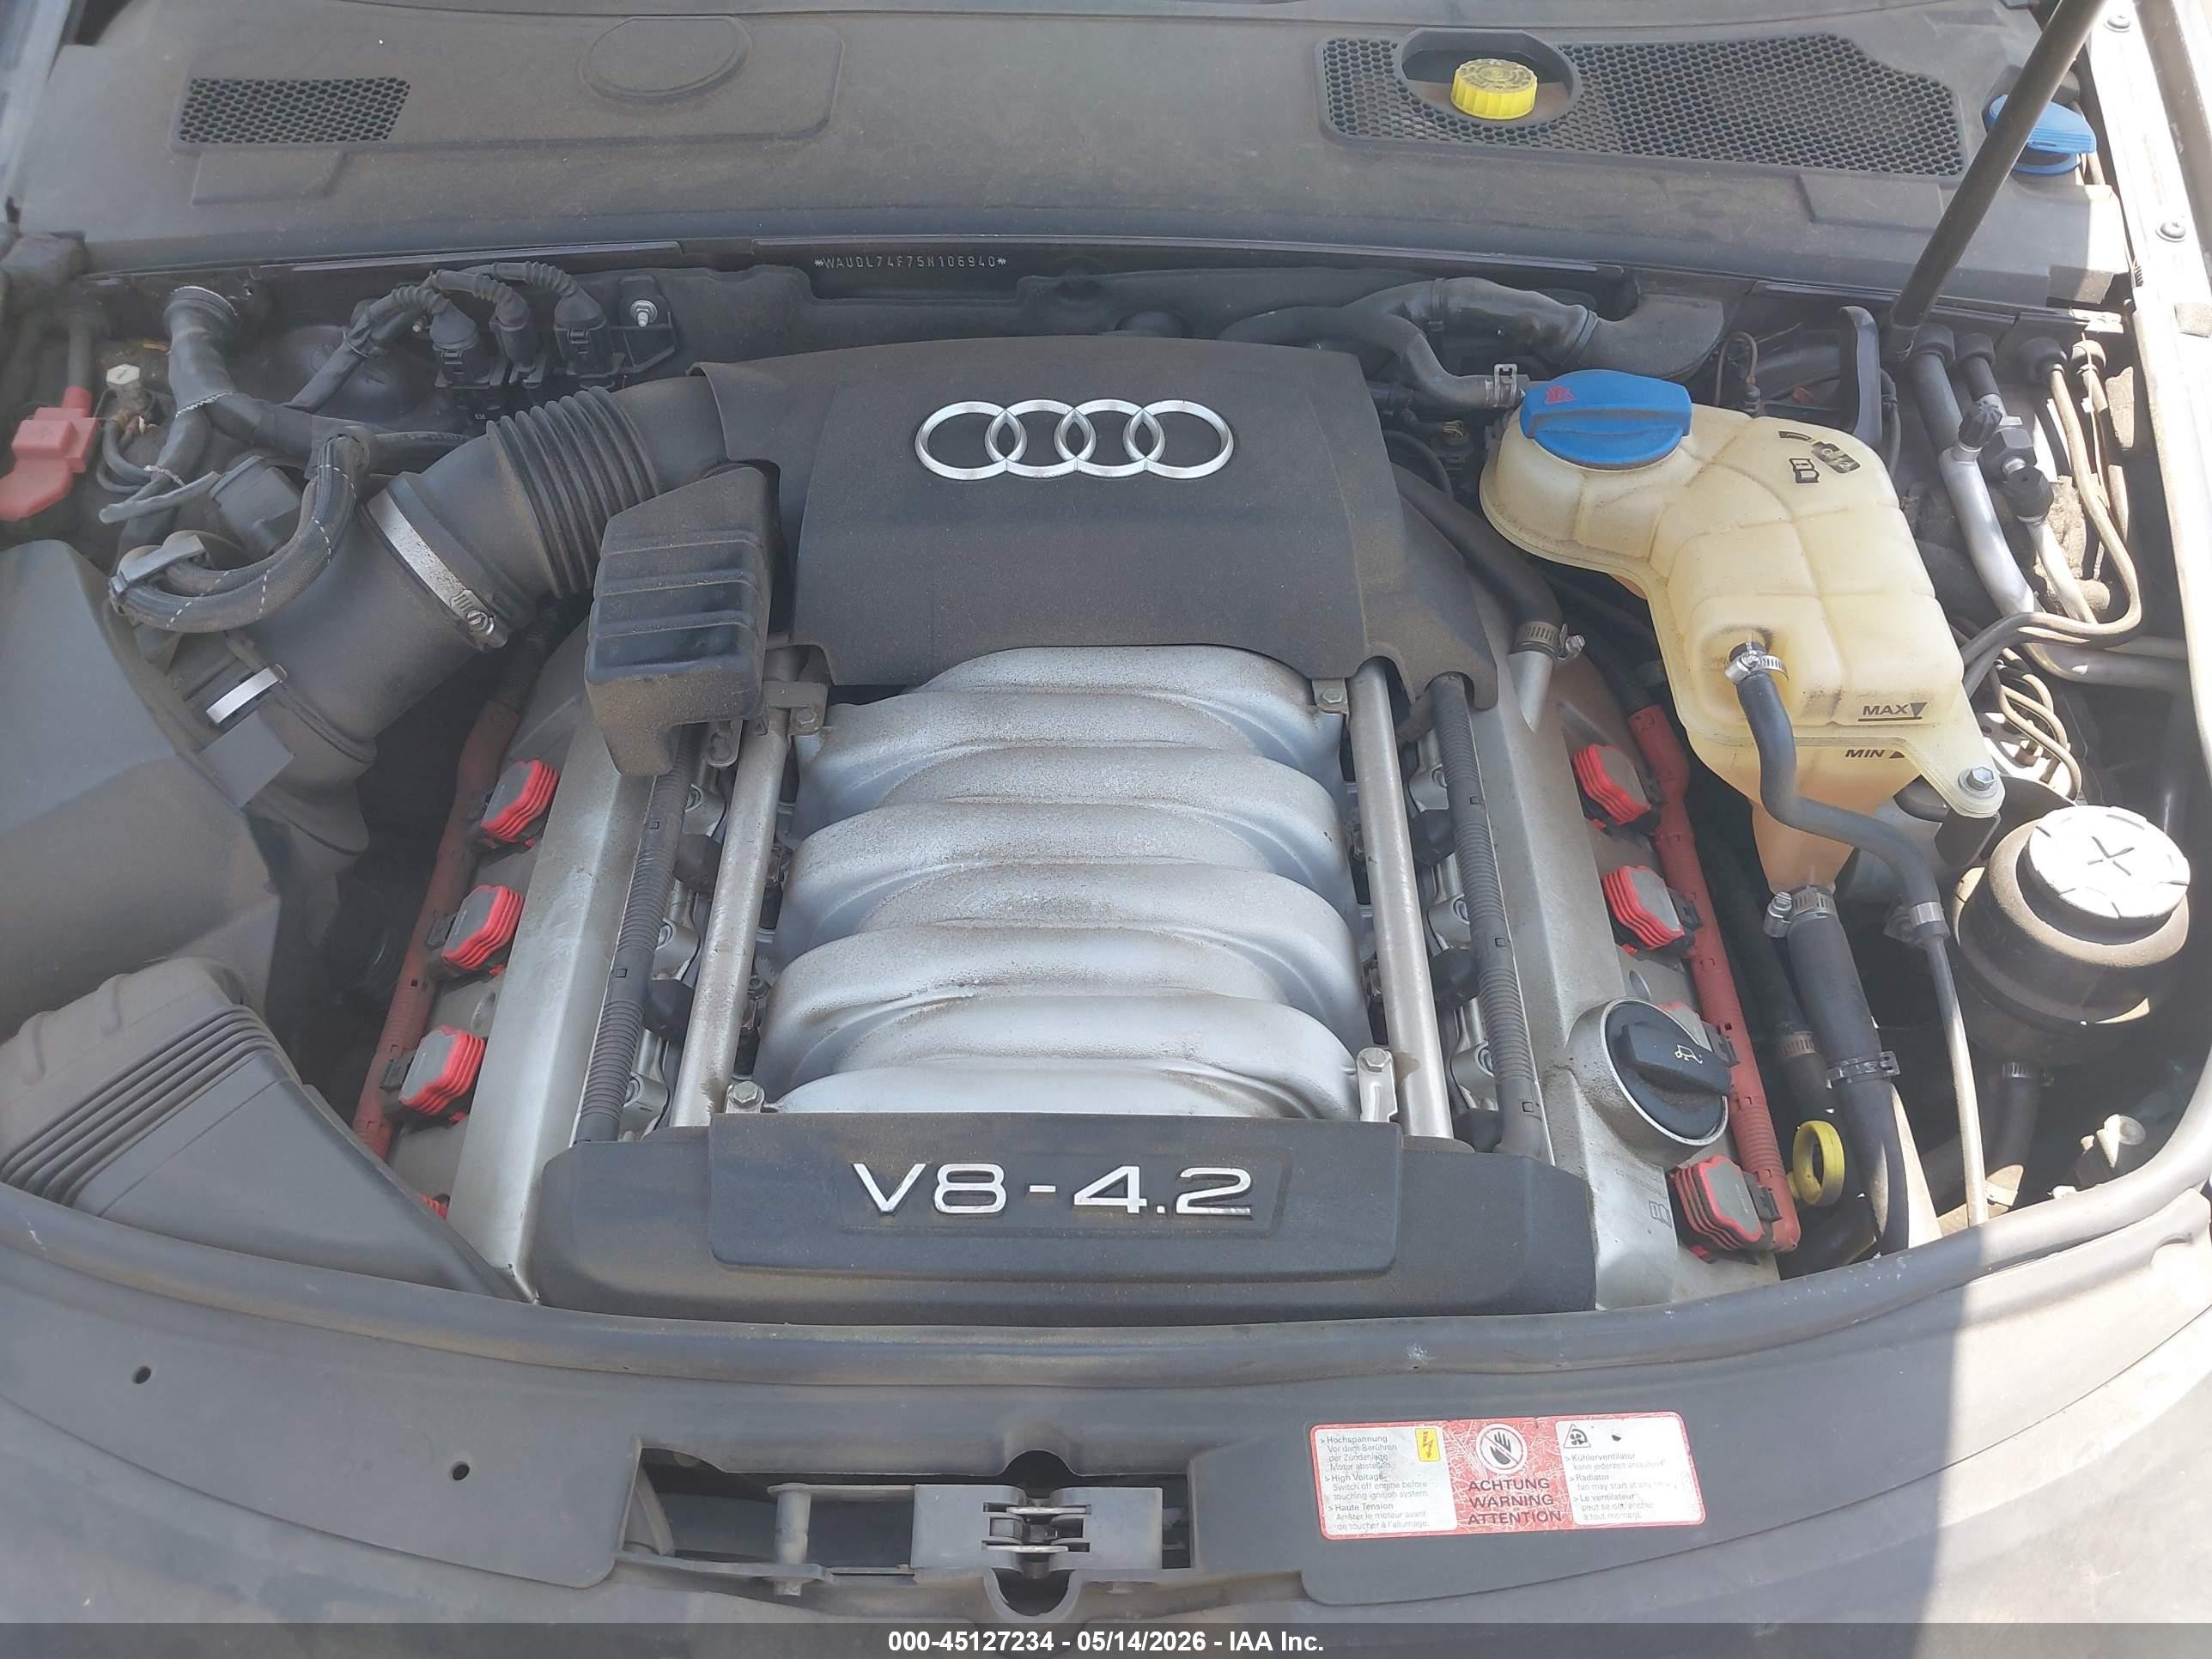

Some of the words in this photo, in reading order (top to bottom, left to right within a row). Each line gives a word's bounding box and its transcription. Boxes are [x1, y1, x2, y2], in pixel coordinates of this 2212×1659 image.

[1862, 704, 1909, 715] MAX
[1844, 749, 1885, 758] MIN
[853, 1163, 1006, 1214] V8
[1073, 1165, 1253, 1216] 4.2
[1327, 1435, 1388, 1444] Hochspannung
[1352, 1474, 1385, 1482] Voltage
[1402, 1480, 1427, 1489] before
[1468, 1478, 1550, 1492] ACHTUNG
[1468, 1494, 1554, 1508] WARNING
[1468, 1510, 1563, 1525] ATTENTION
